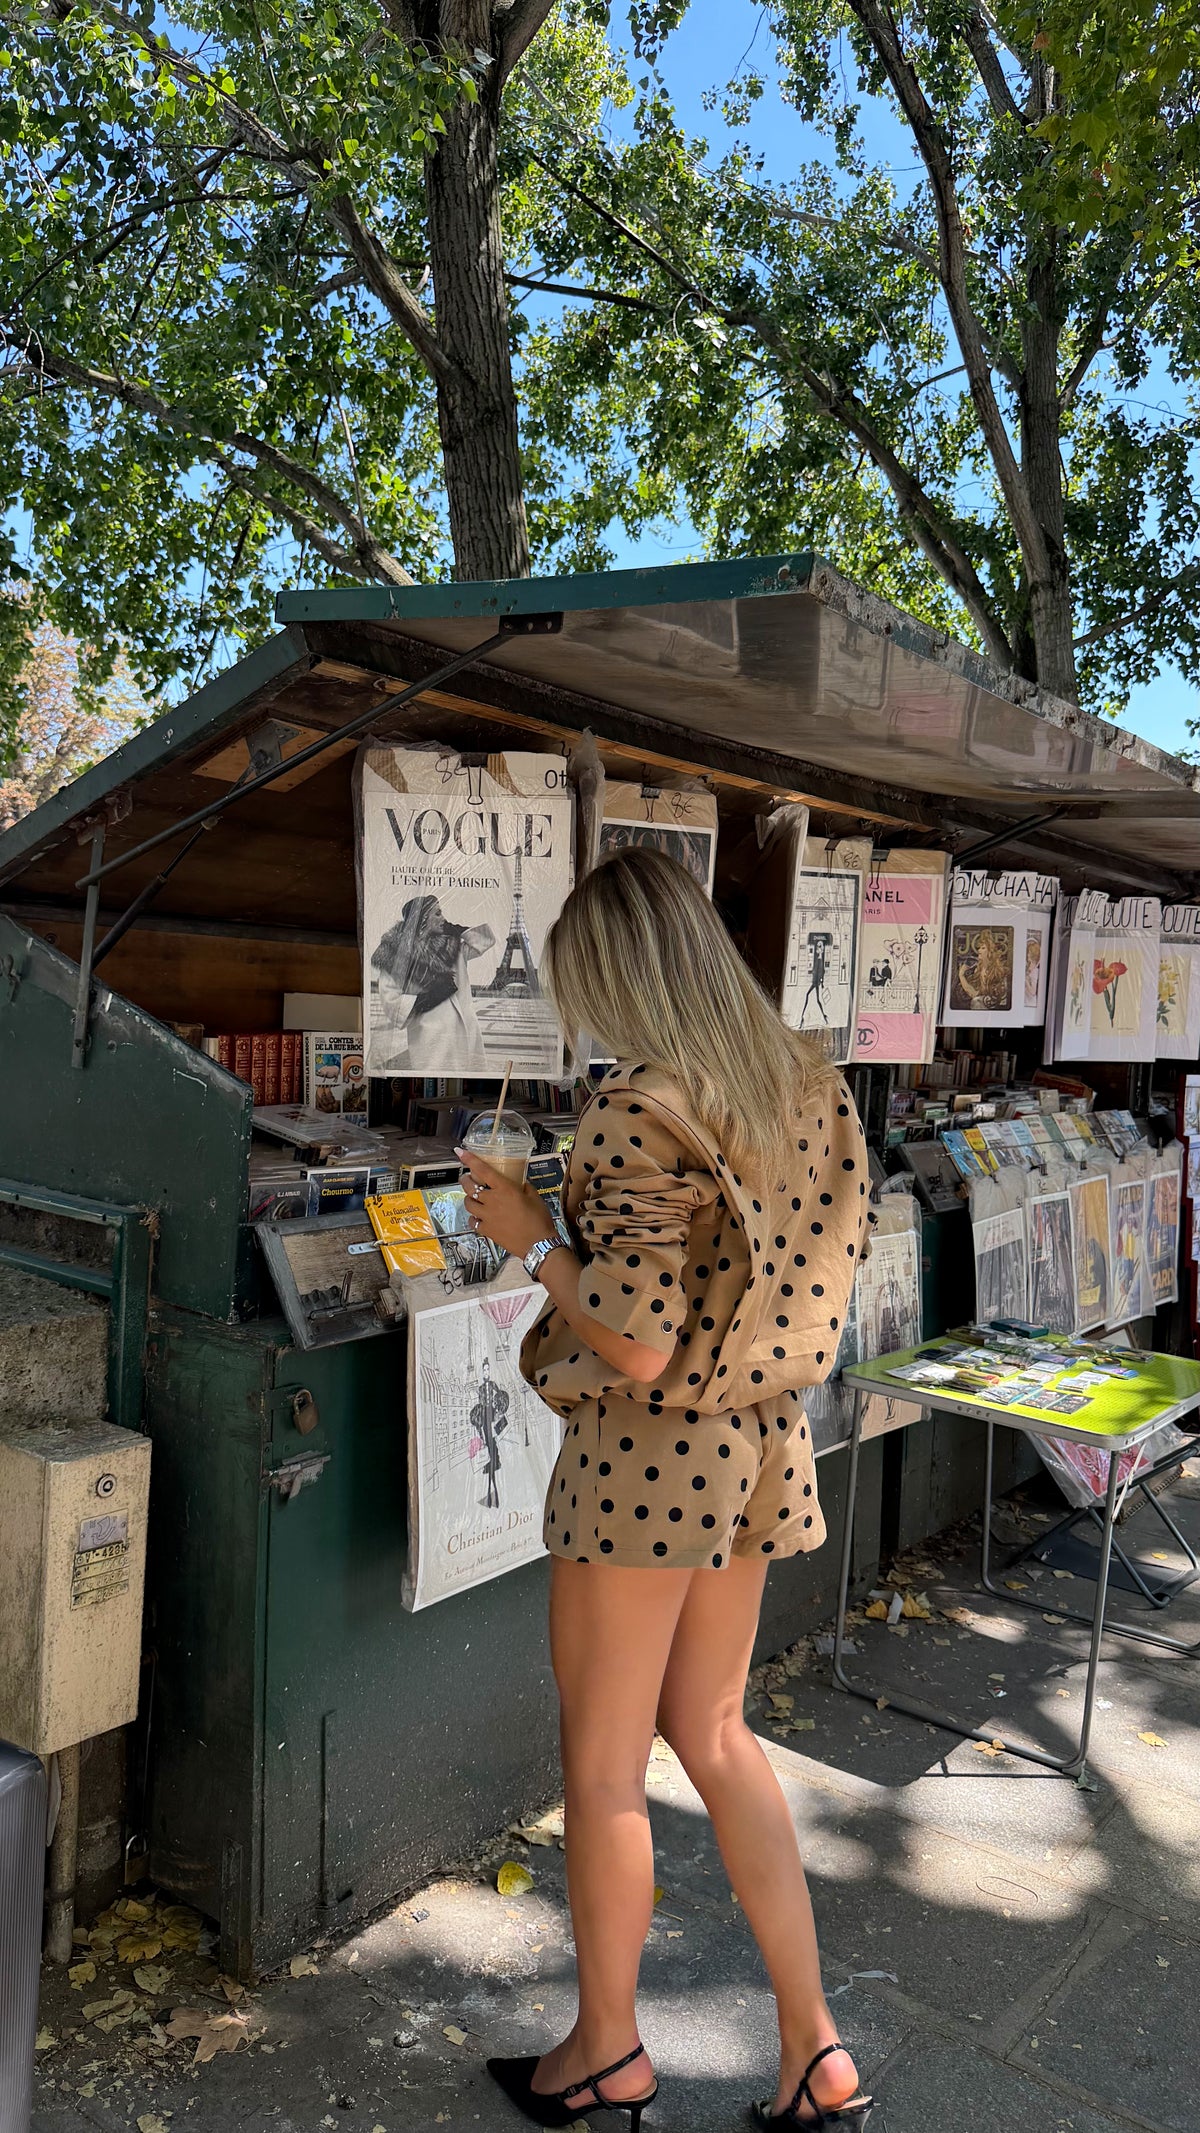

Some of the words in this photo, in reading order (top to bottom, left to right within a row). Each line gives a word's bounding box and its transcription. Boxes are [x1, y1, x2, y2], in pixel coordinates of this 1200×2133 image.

[671, 792, 695, 819] 8€
[381, 808, 552, 857] VOGUE
[391, 876, 443, 887] L'ESPRIT
[449, 877, 500, 888] PARISIEN
[970, 875, 1031, 897] MUCHA
[865, 890, 904, 903] ANEL
[1160, 906, 1200, 934] OUTE
[321, 1188, 354, 1196] Chourmo
[447, 1525, 502, 1555] Christian
[507, 1511, 535, 1531] Dior
